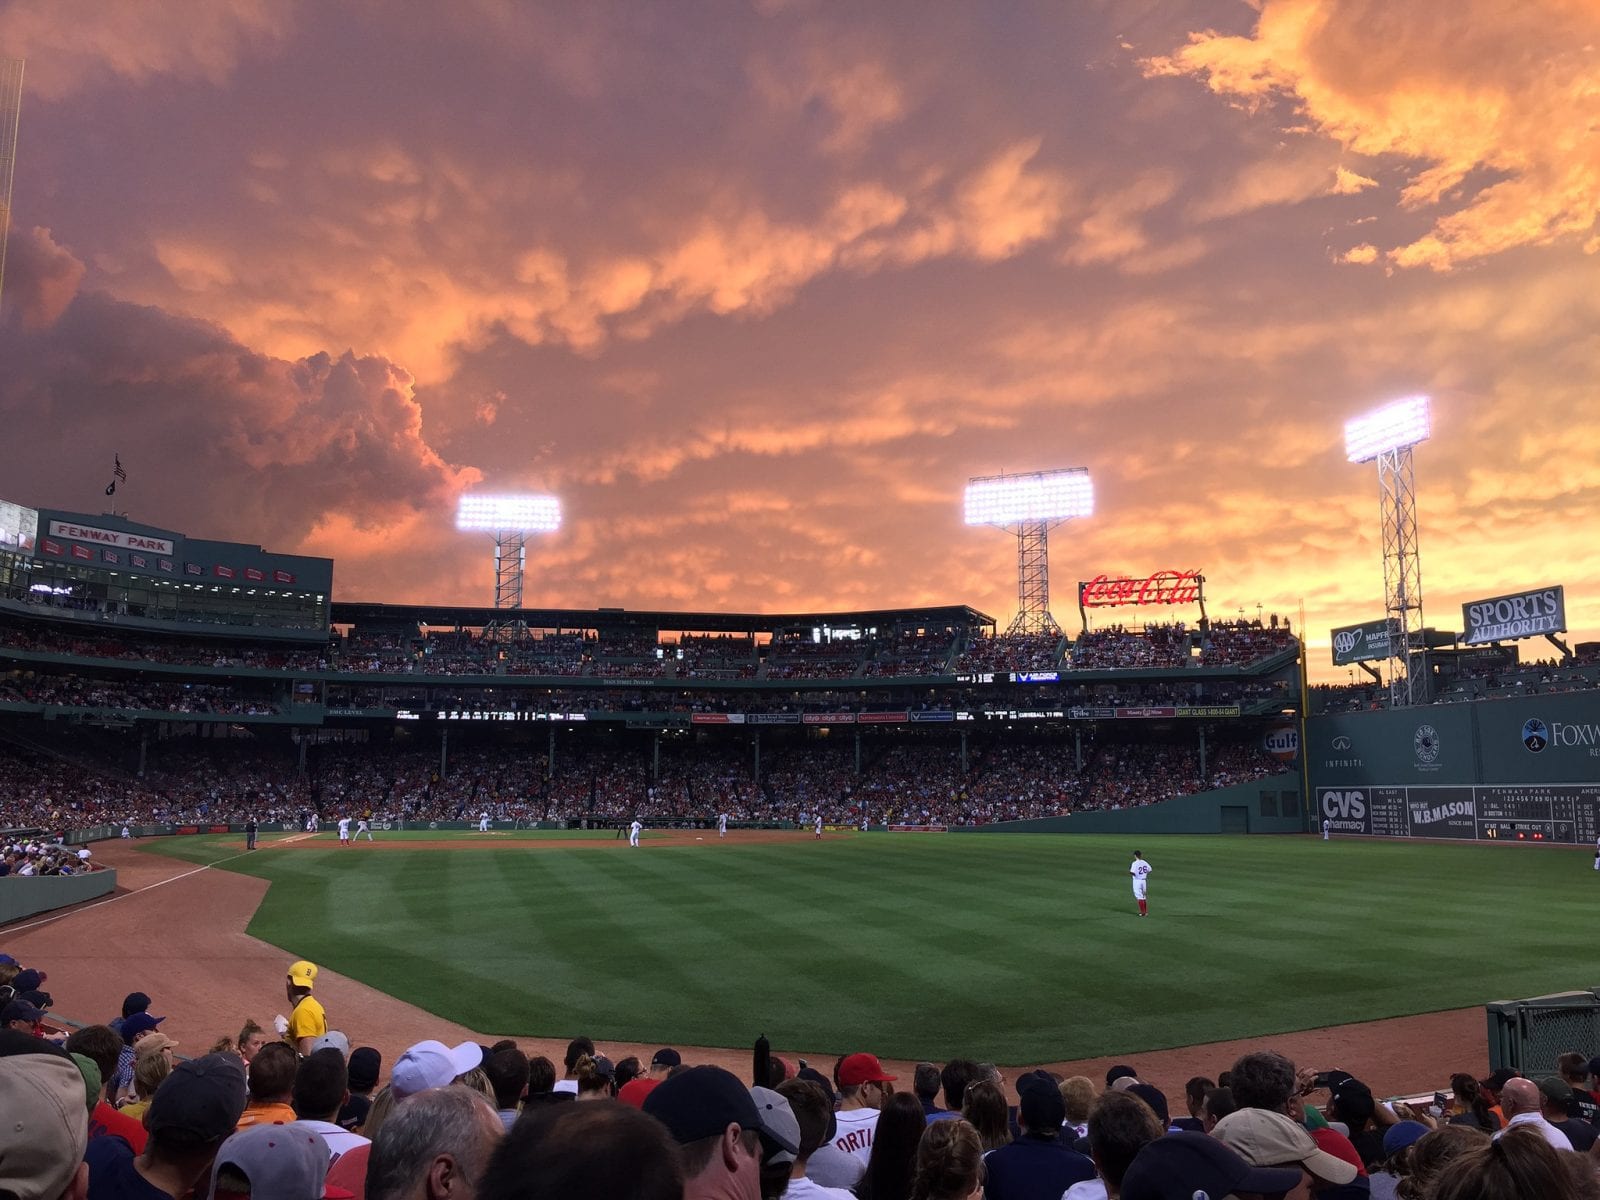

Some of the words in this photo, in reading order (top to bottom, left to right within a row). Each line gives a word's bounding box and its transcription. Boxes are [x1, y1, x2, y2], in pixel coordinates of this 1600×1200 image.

[58, 525, 119, 543] FENWAY
[128, 537, 165, 552] PARK
[1469, 591, 1556, 627] SPORTS
[1366, 631, 1390, 641] MAPFR
[1471, 615, 1558, 640] AUTHORITY
[1335, 632, 1354, 652] AAA
[1265, 733, 1297, 749] Gulf
[1325, 759, 1362, 768] INFINITI
[1322, 791, 1366, 819] CVS
[1138, 865, 1148, 875] 26
[836, 1128, 872, 1154] ORTI
